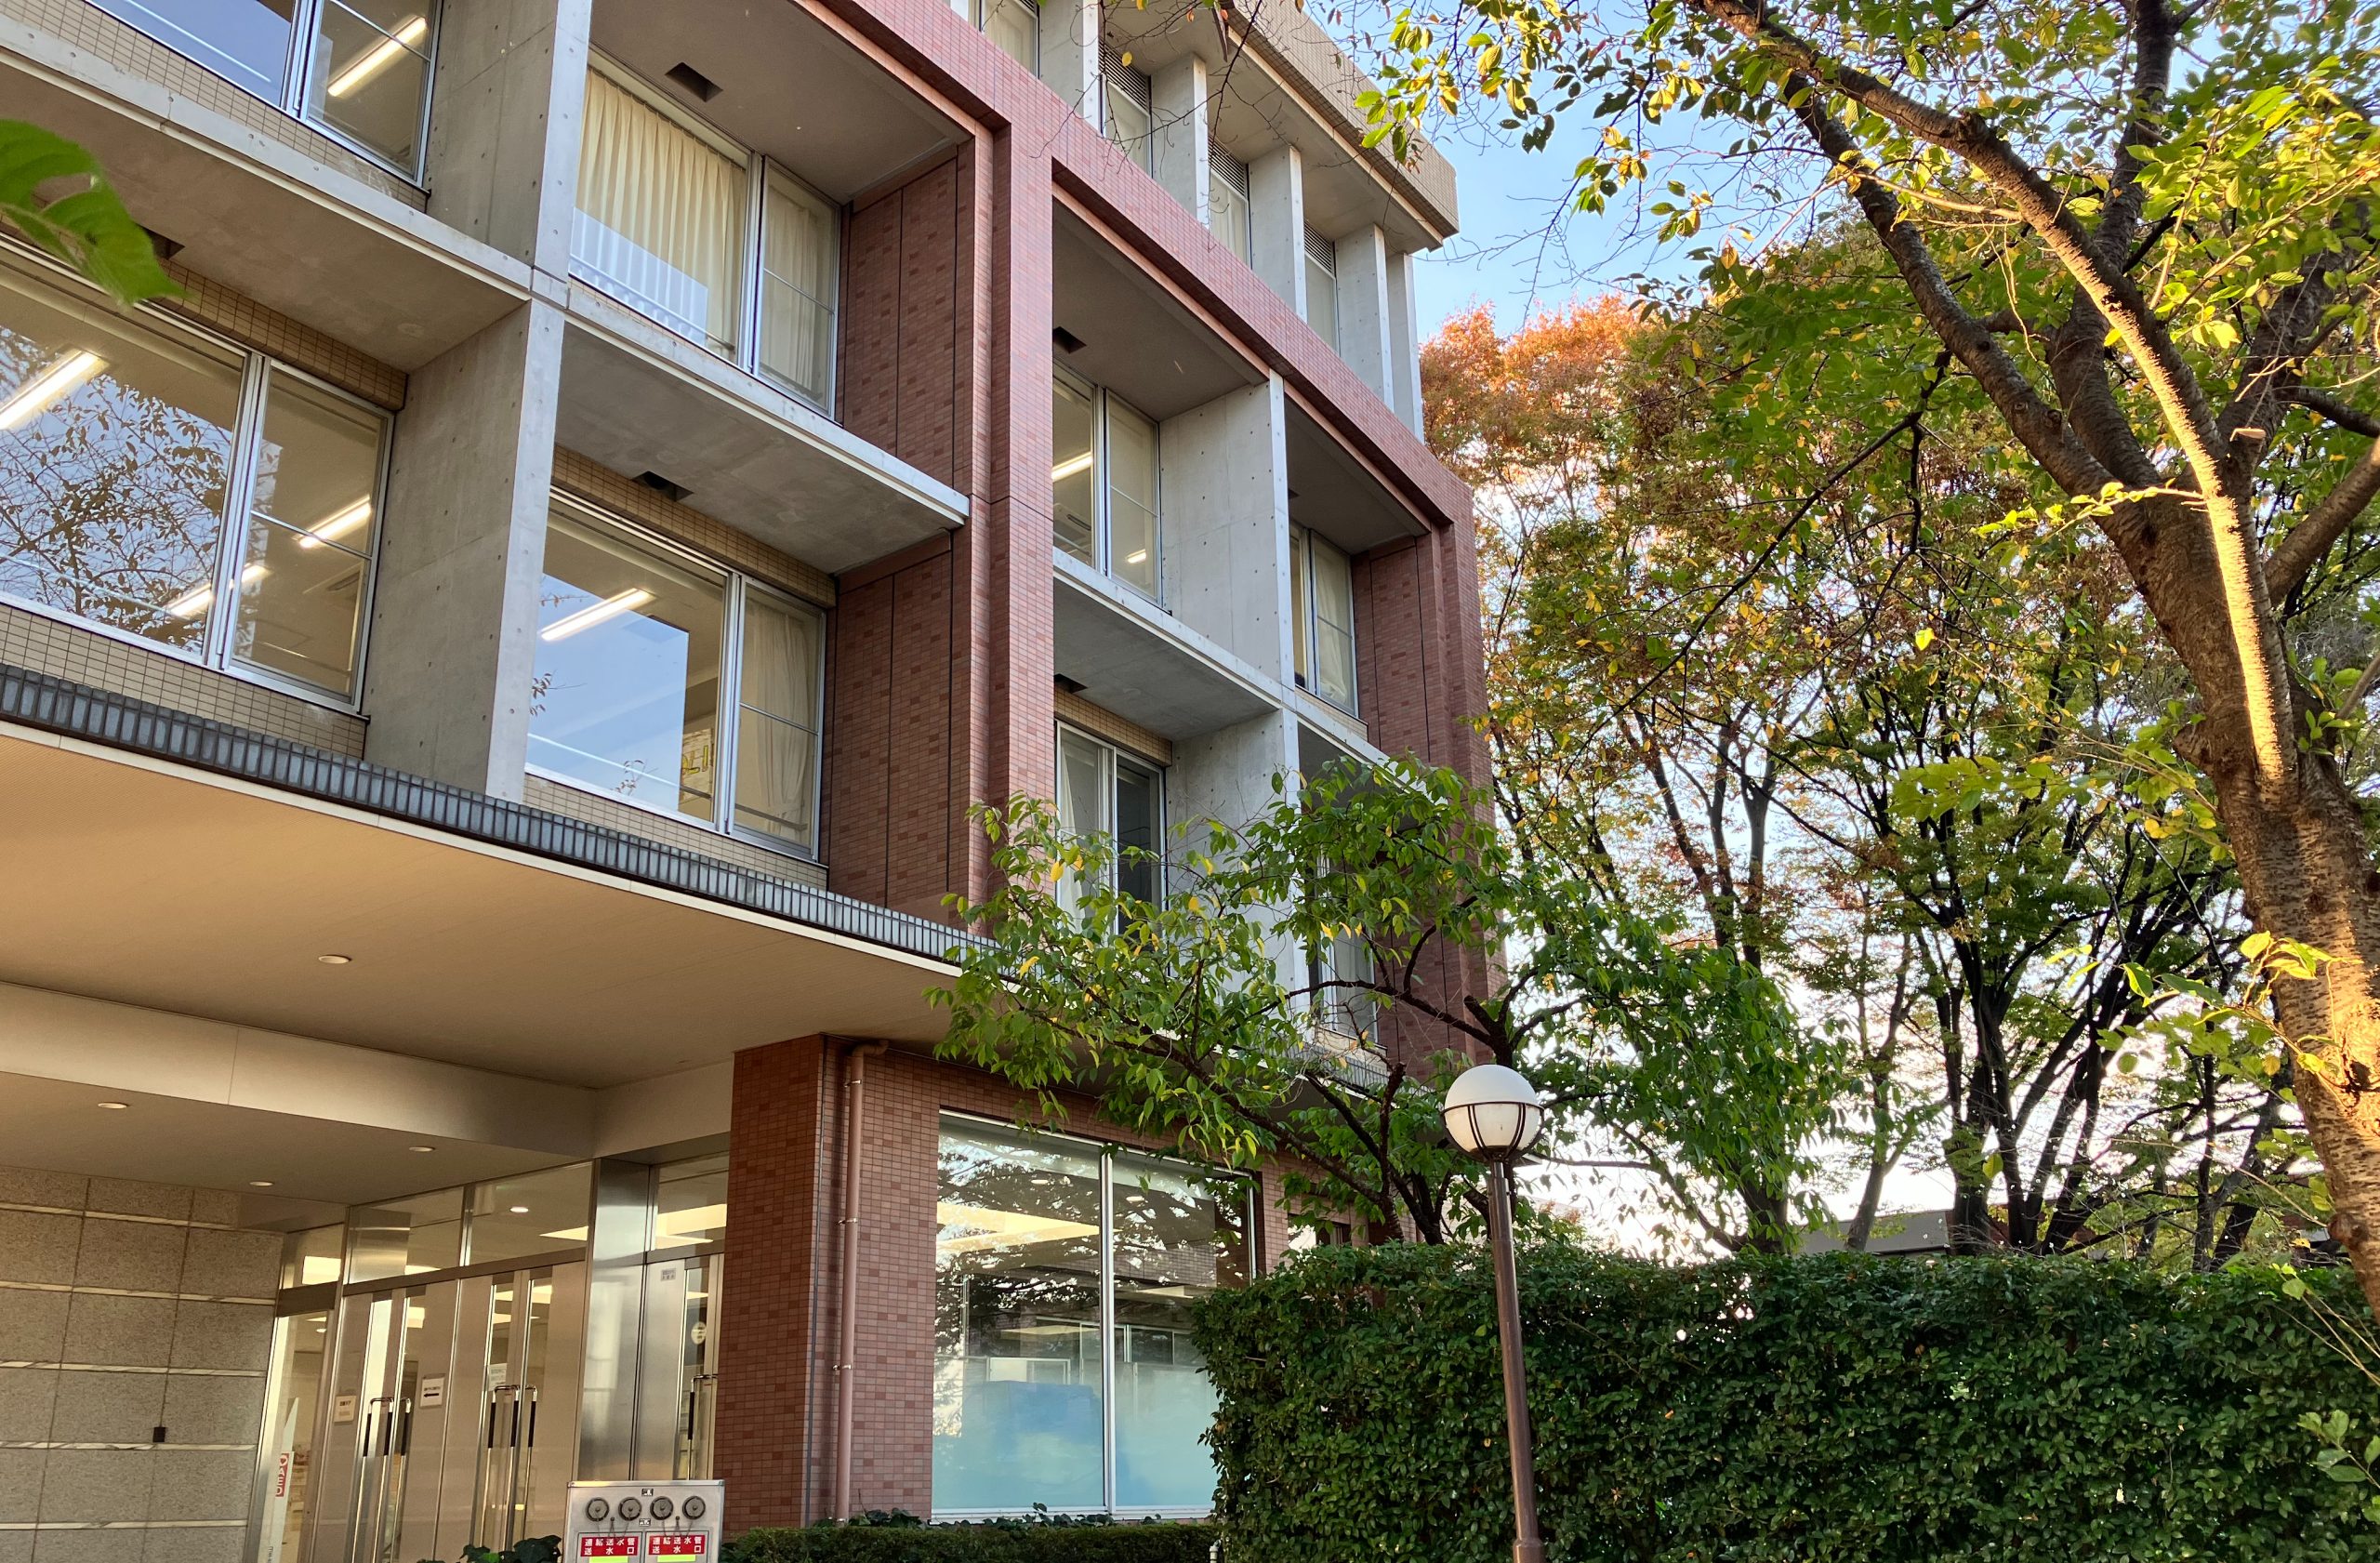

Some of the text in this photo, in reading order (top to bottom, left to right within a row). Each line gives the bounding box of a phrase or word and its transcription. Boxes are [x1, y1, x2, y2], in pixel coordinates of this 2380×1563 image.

[584, 1546, 635, 1556] 送水口
[652, 1544, 702, 1554] 送水口
